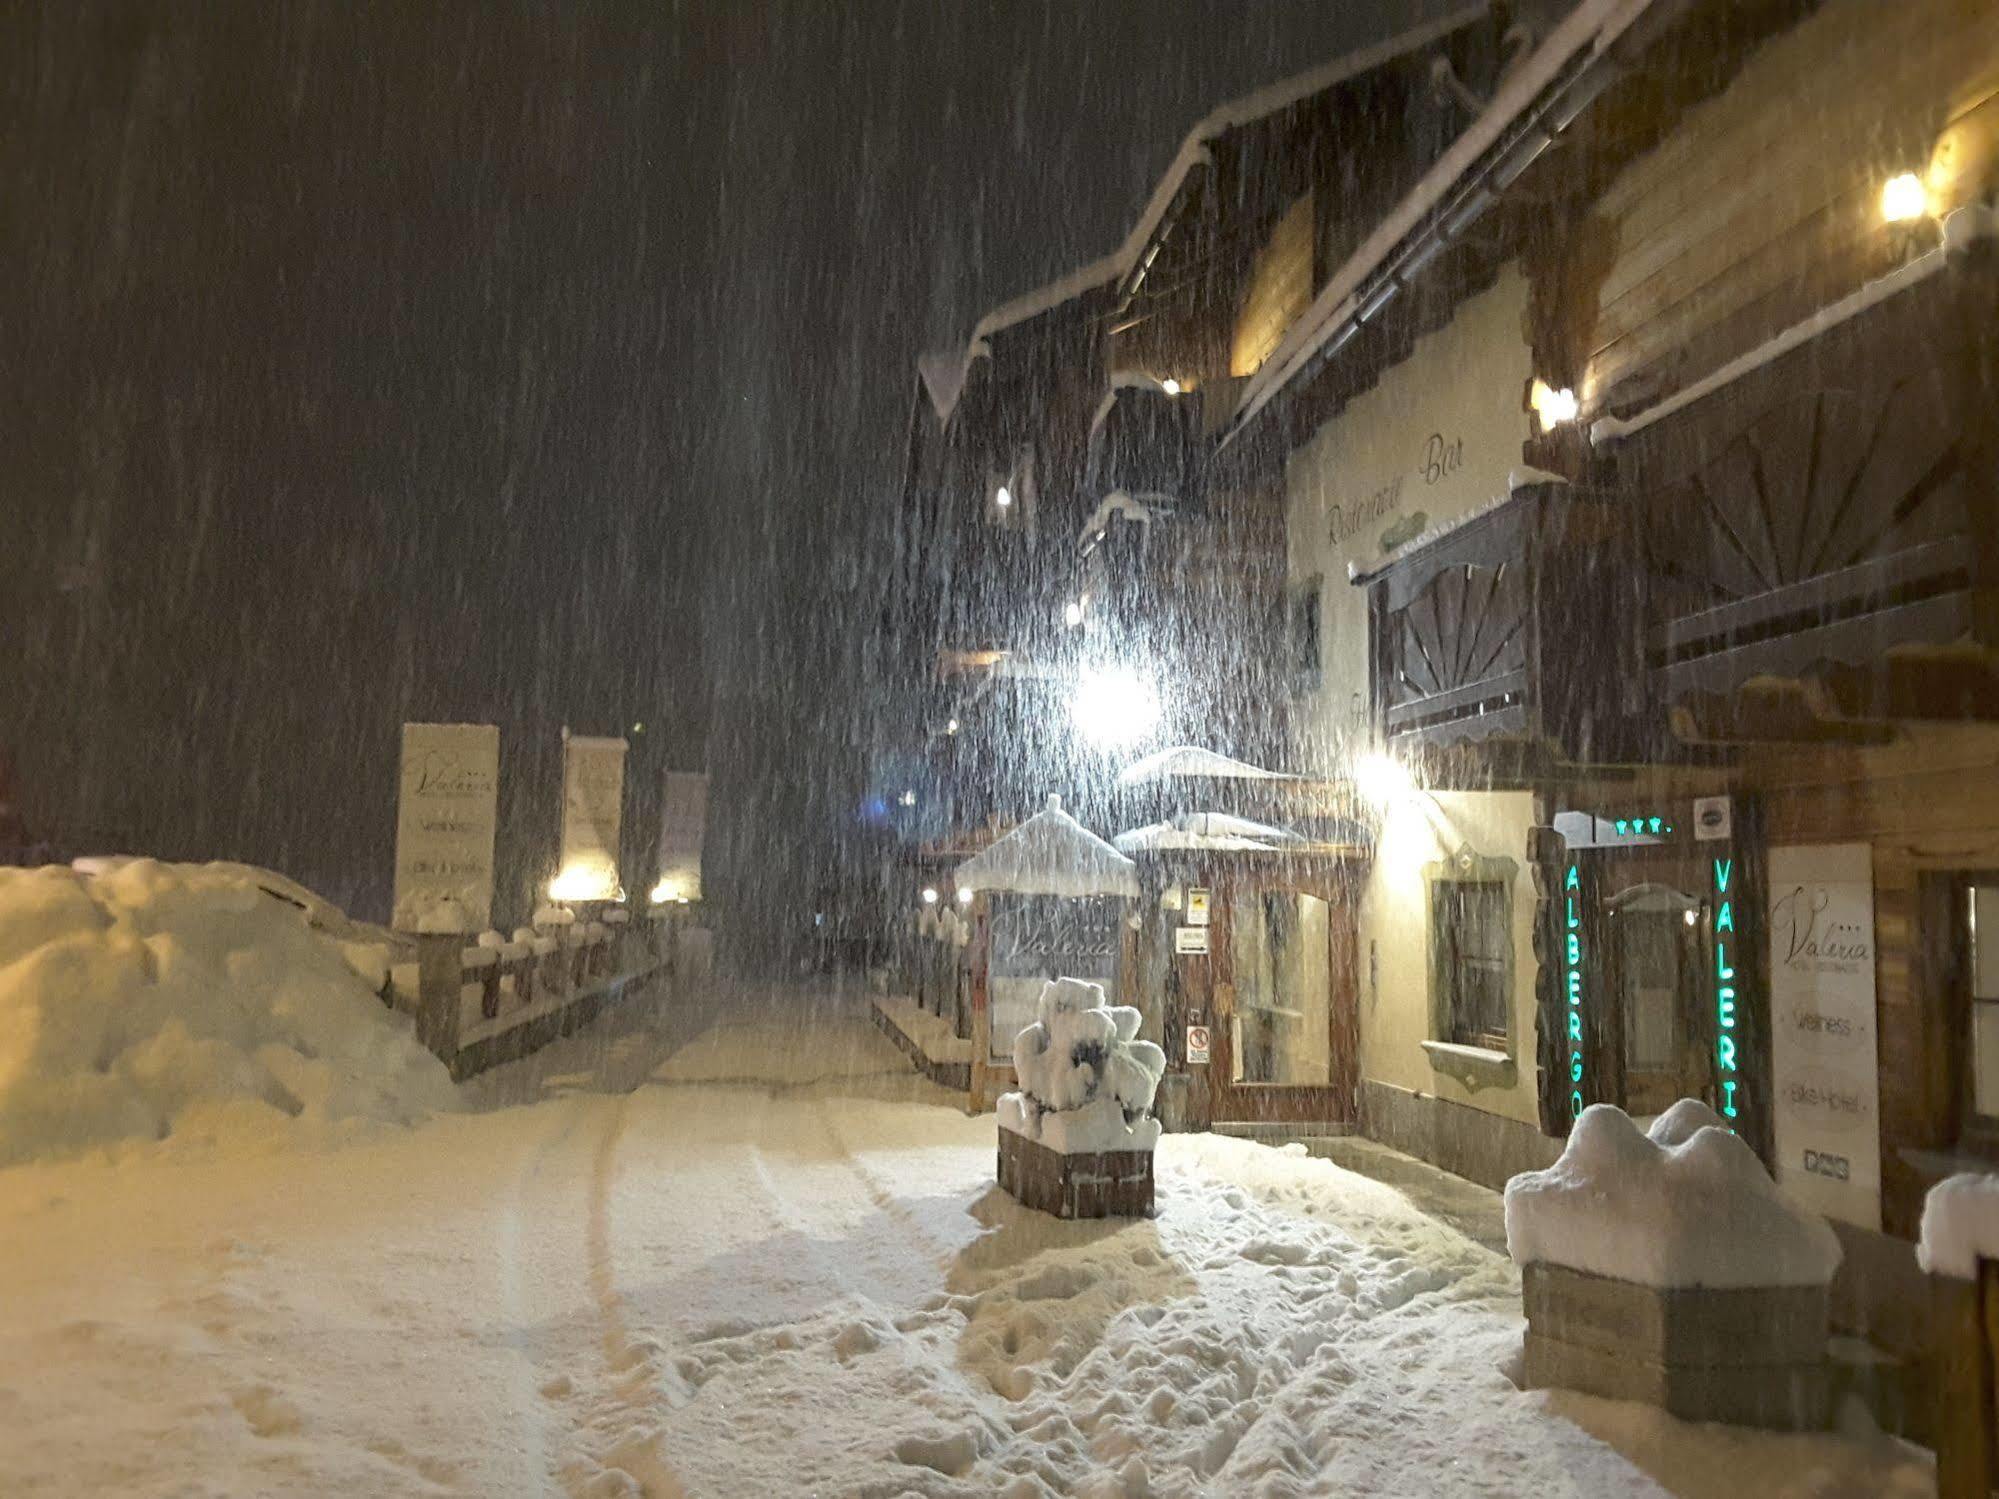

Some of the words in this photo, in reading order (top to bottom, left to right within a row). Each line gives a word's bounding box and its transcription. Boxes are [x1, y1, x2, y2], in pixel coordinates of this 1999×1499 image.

[1419, 432, 1464, 486] Bar
[1567, 864, 1583, 1120] ALBERGO
[1714, 858, 1738, 1135] VALERI
